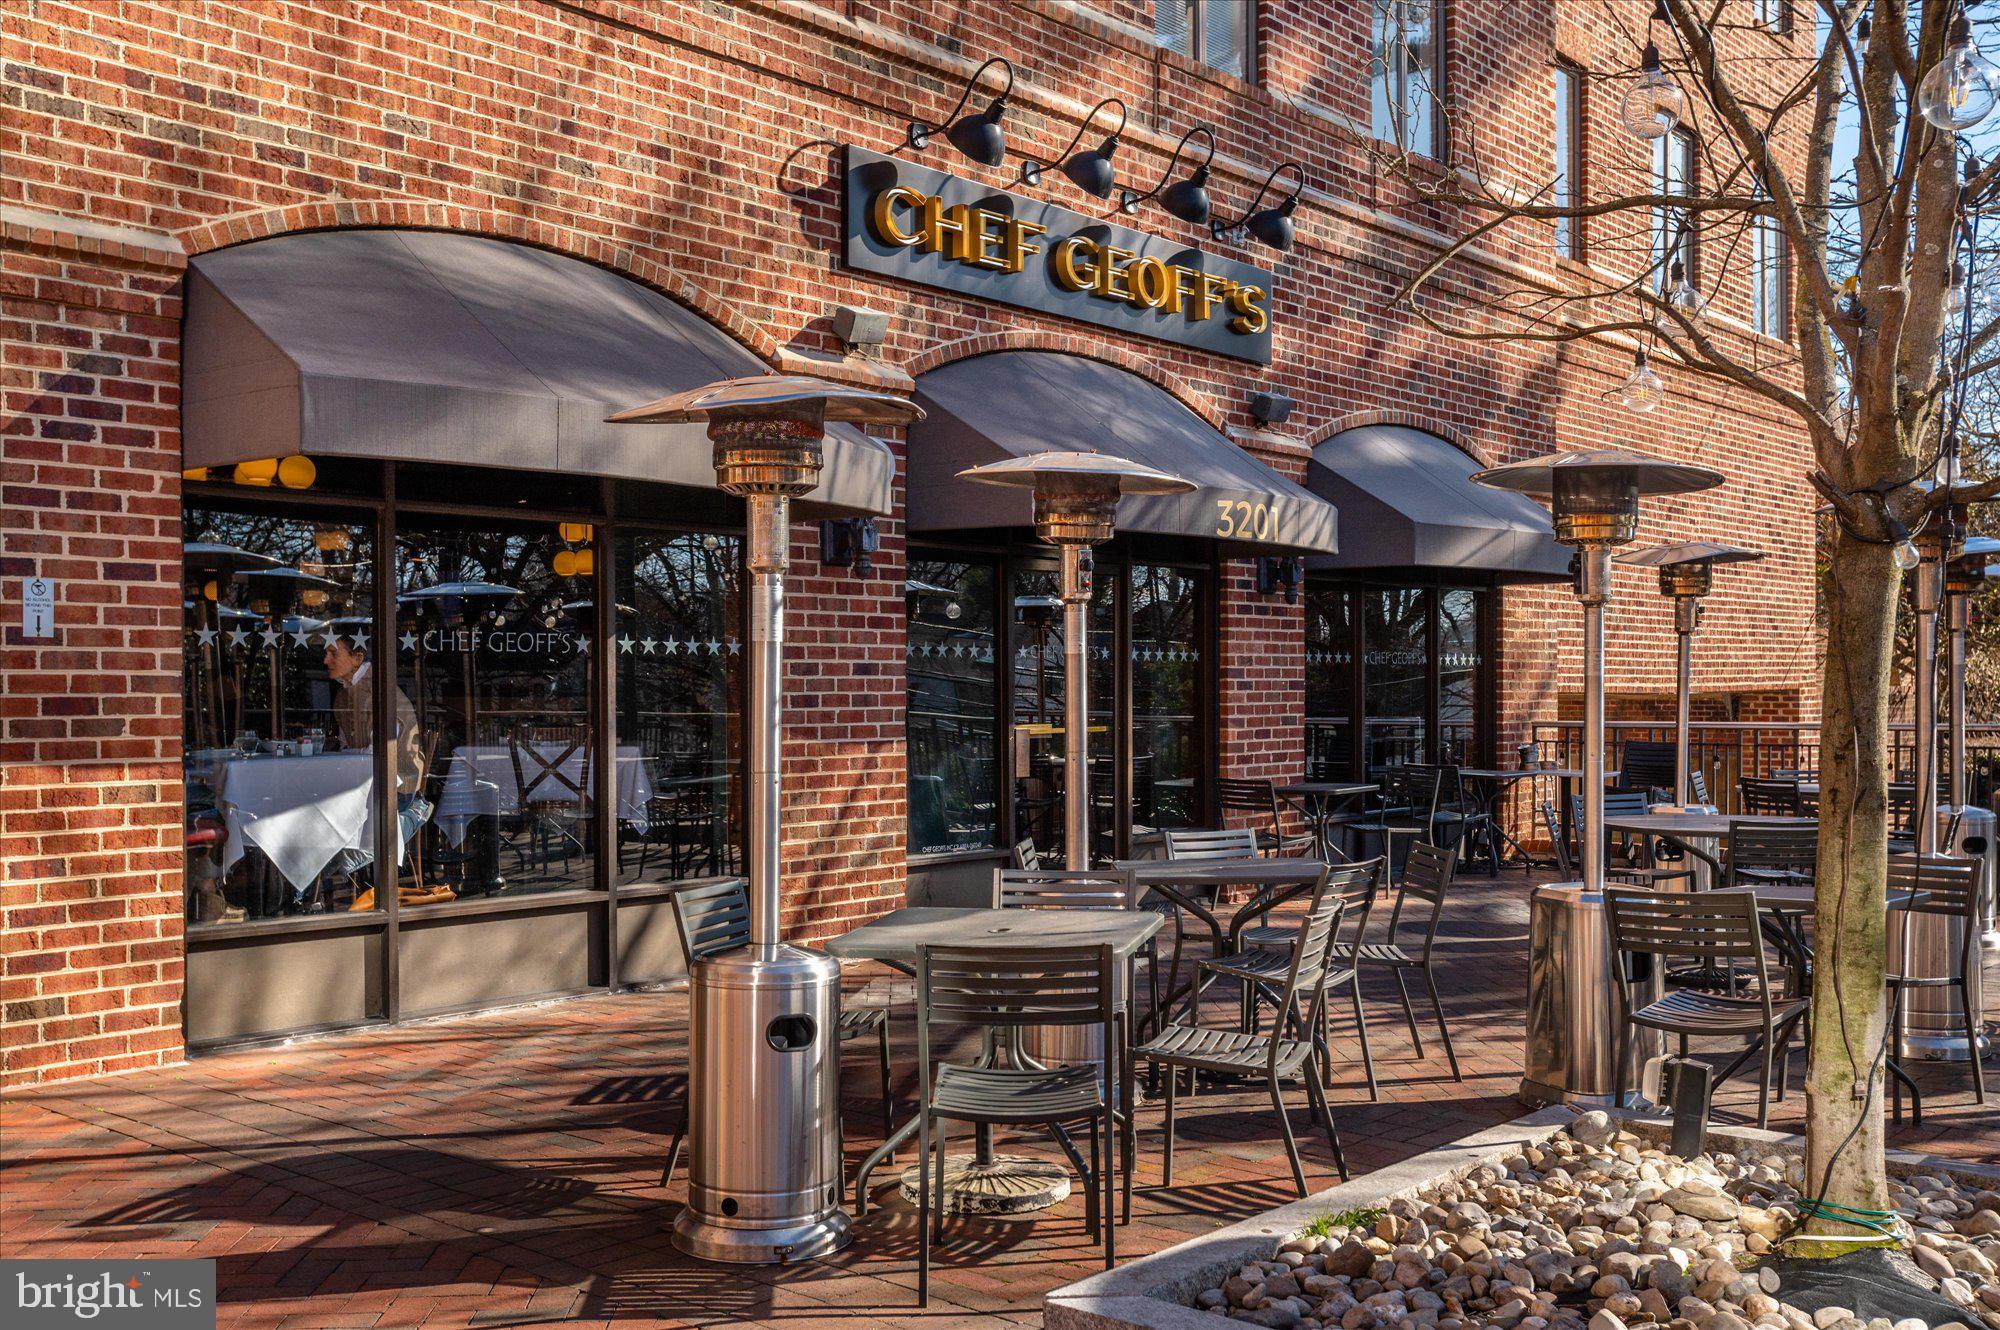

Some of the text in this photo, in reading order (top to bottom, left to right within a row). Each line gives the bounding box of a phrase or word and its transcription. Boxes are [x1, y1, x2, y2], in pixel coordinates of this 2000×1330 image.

[875, 185, 1268, 335] CHEF GEOFF'S
[1216, 500, 1279, 542] 3201
[423, 629, 571, 654] CHEF GEOFF'S
[1369, 651, 1390, 665] CHEF
